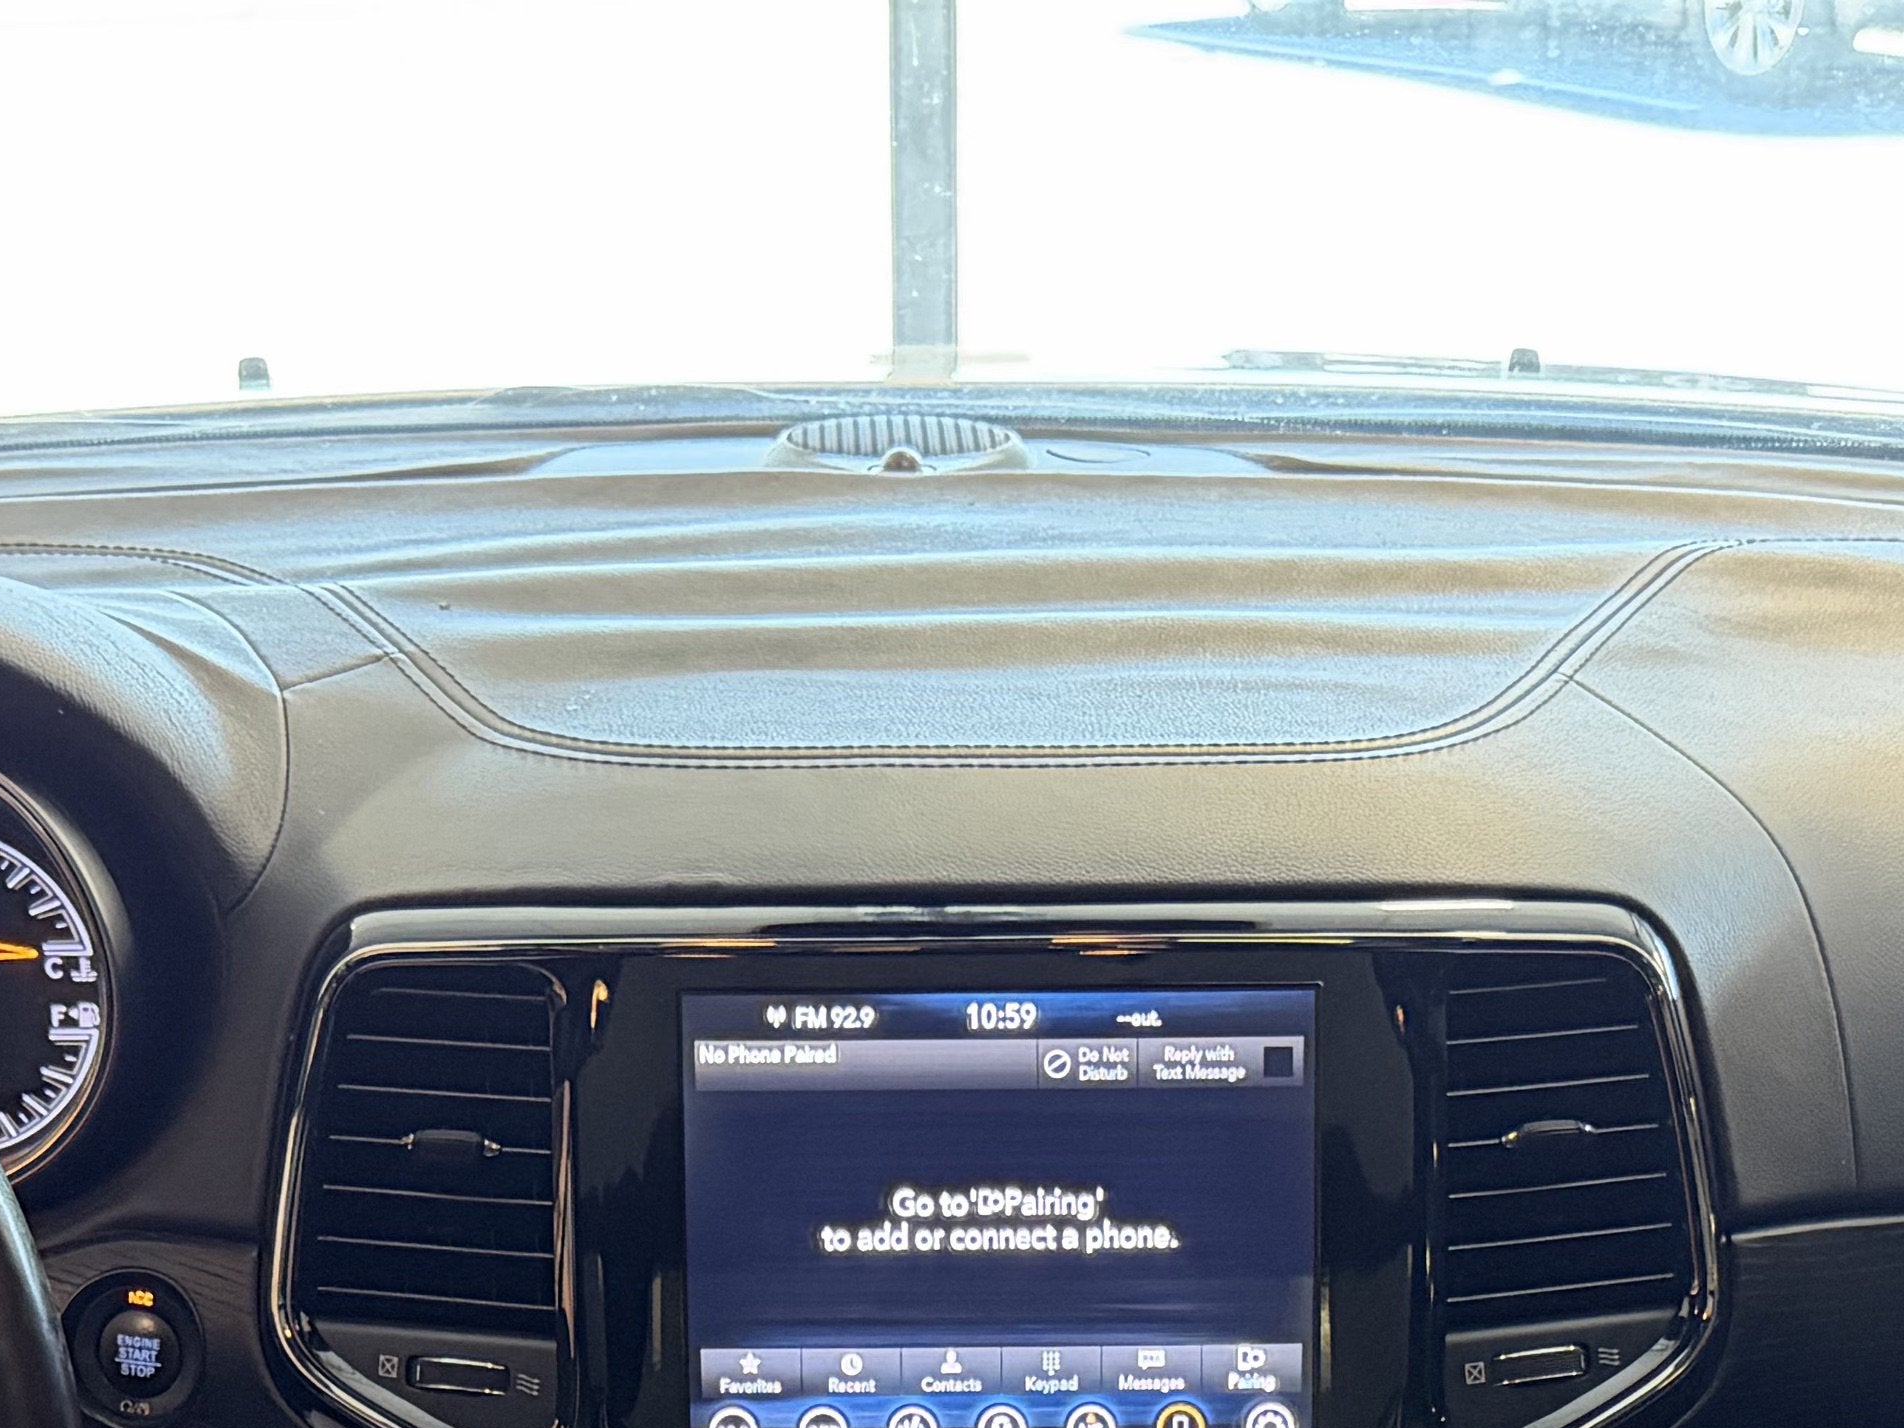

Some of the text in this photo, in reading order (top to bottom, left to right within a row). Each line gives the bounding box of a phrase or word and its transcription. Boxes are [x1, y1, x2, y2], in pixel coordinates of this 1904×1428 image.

[43, 957, 63, 979] C
[50, 1006, 65, 1027] F
[795, 1004, 876, 1029] FM 92.9
[967, 1001, 1037, 1030] 10:59
[699, 1044, 837, 1064] No Phone Paired
[1078, 1046, 1129, 1063] Do Not
[1165, 1045, 1235, 1064] Reply with
[1079, 1065, 1128, 1081] Disturb
[1153, 1063, 1246, 1083] Text Message
[893, 1187, 935, 1217] Go
[939, 1190, 969, 1217] to
[821, 1218, 1180, 1254] to add or connect a phone.
[117, 1333, 161, 1351] ENGINE
[118, 1347, 158, 1363] START
[120, 1363, 156, 1378] STOP
[720, 1377, 782, 1394] Favorites
[828, 1377, 876, 1393] Recent
[921, 1376, 982, 1393] Contacts
[1024, 1375, 1079, 1394] Keypad
[1118, 1374, 1185, 1393] Messages
[1228, 1372, 1276, 1393] Pairing
